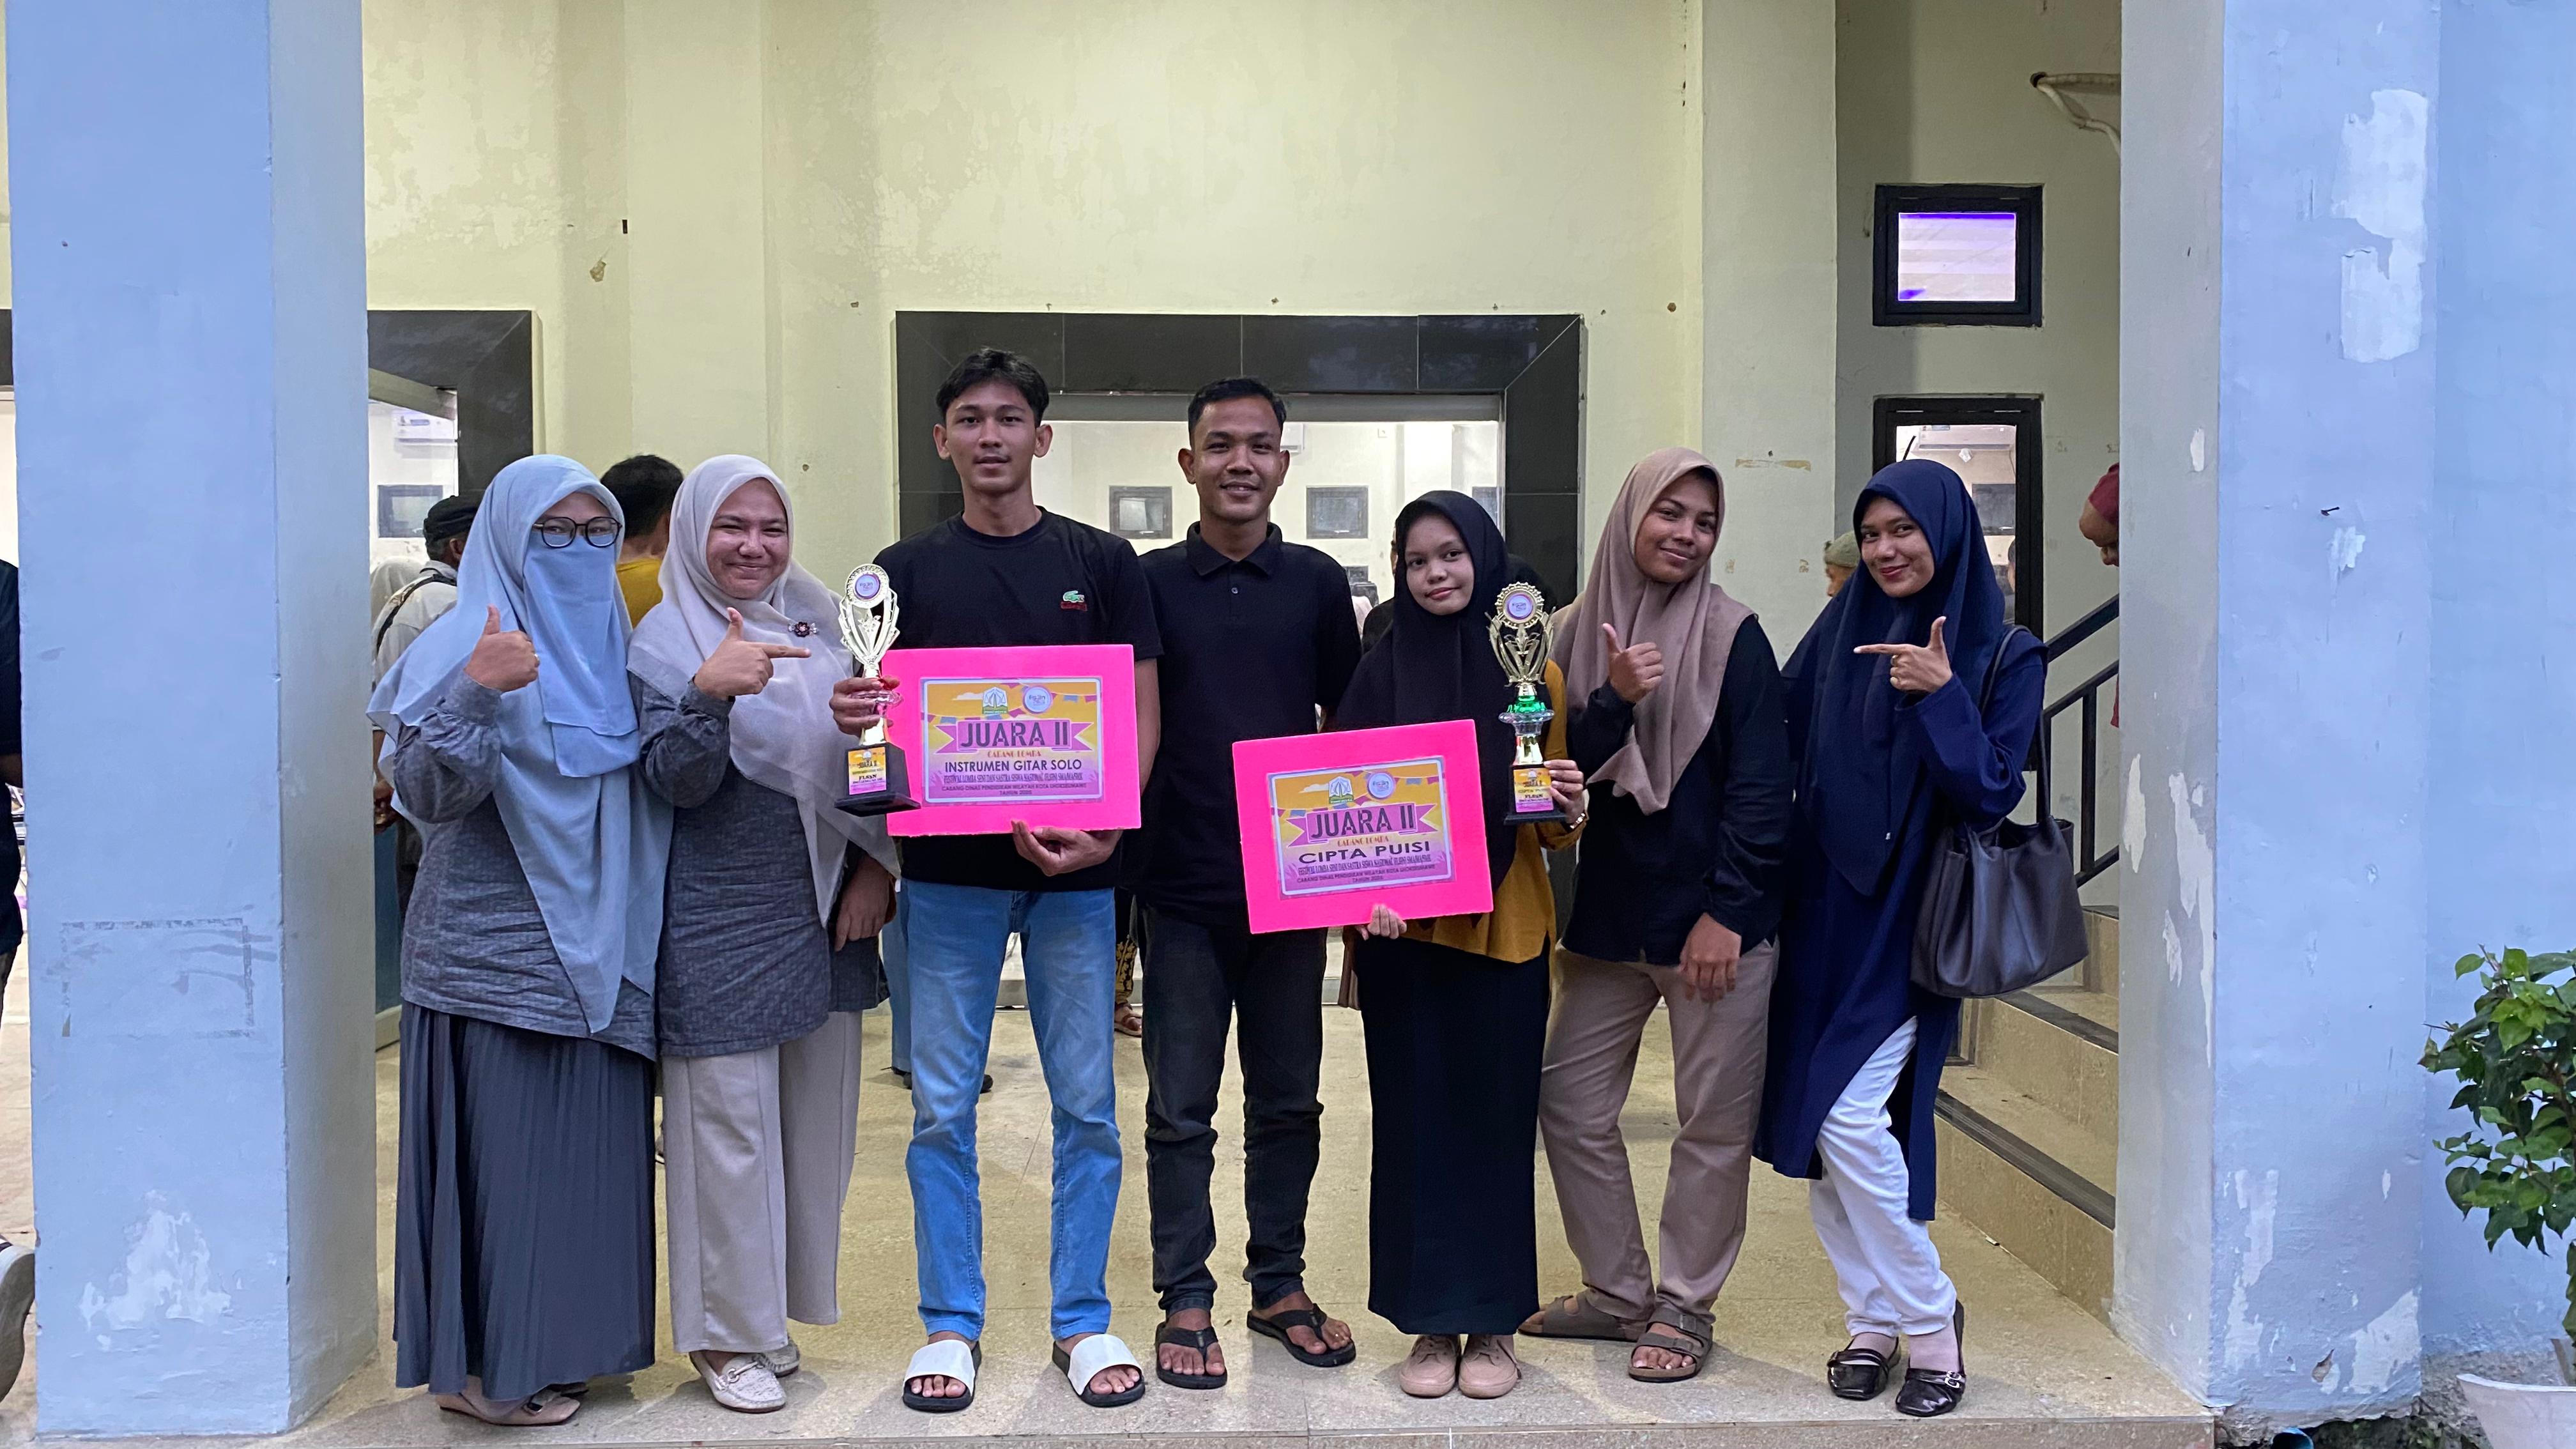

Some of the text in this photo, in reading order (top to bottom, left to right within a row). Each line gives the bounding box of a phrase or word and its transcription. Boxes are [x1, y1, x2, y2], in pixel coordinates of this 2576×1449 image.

[960, 721, 1068, 747] JUARA II
[945, 759, 1082, 772] INSTRUMEN GITAR SOLO
[1311, 805, 1414, 838] JUARA II
[1299, 841, 1430, 864] CIPTA PUISI
